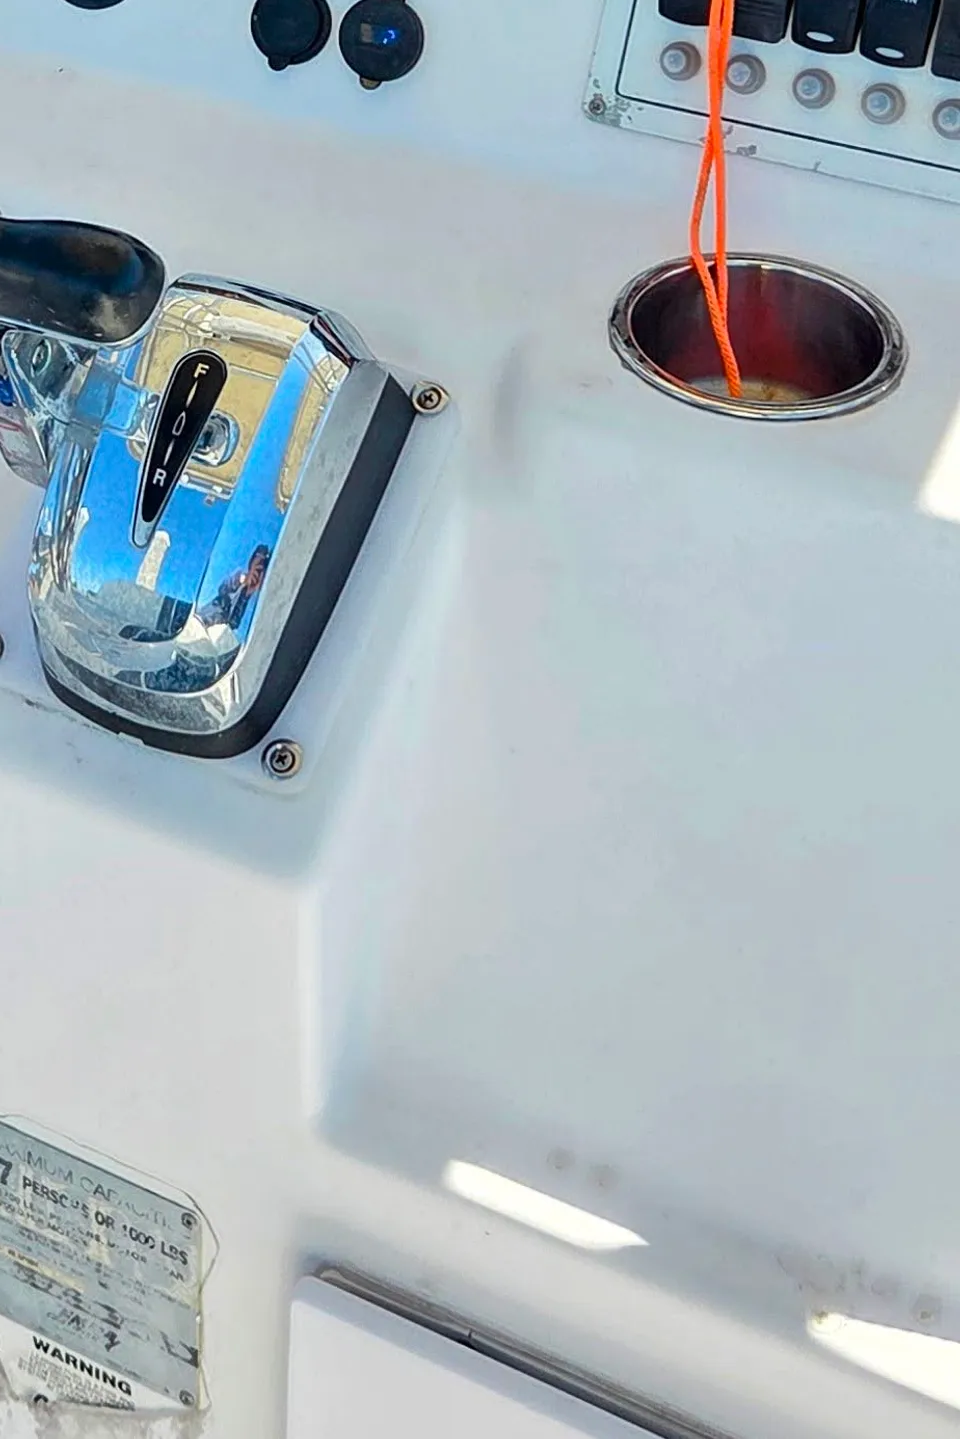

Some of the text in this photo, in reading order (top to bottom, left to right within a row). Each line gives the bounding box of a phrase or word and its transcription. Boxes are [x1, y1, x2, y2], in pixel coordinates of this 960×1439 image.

[193, 362, 210, 378] F
[152, 468, 167, 487] R
[95, 1211, 116, 1230] OR
[32, 1336, 132, 1396] WARNING
